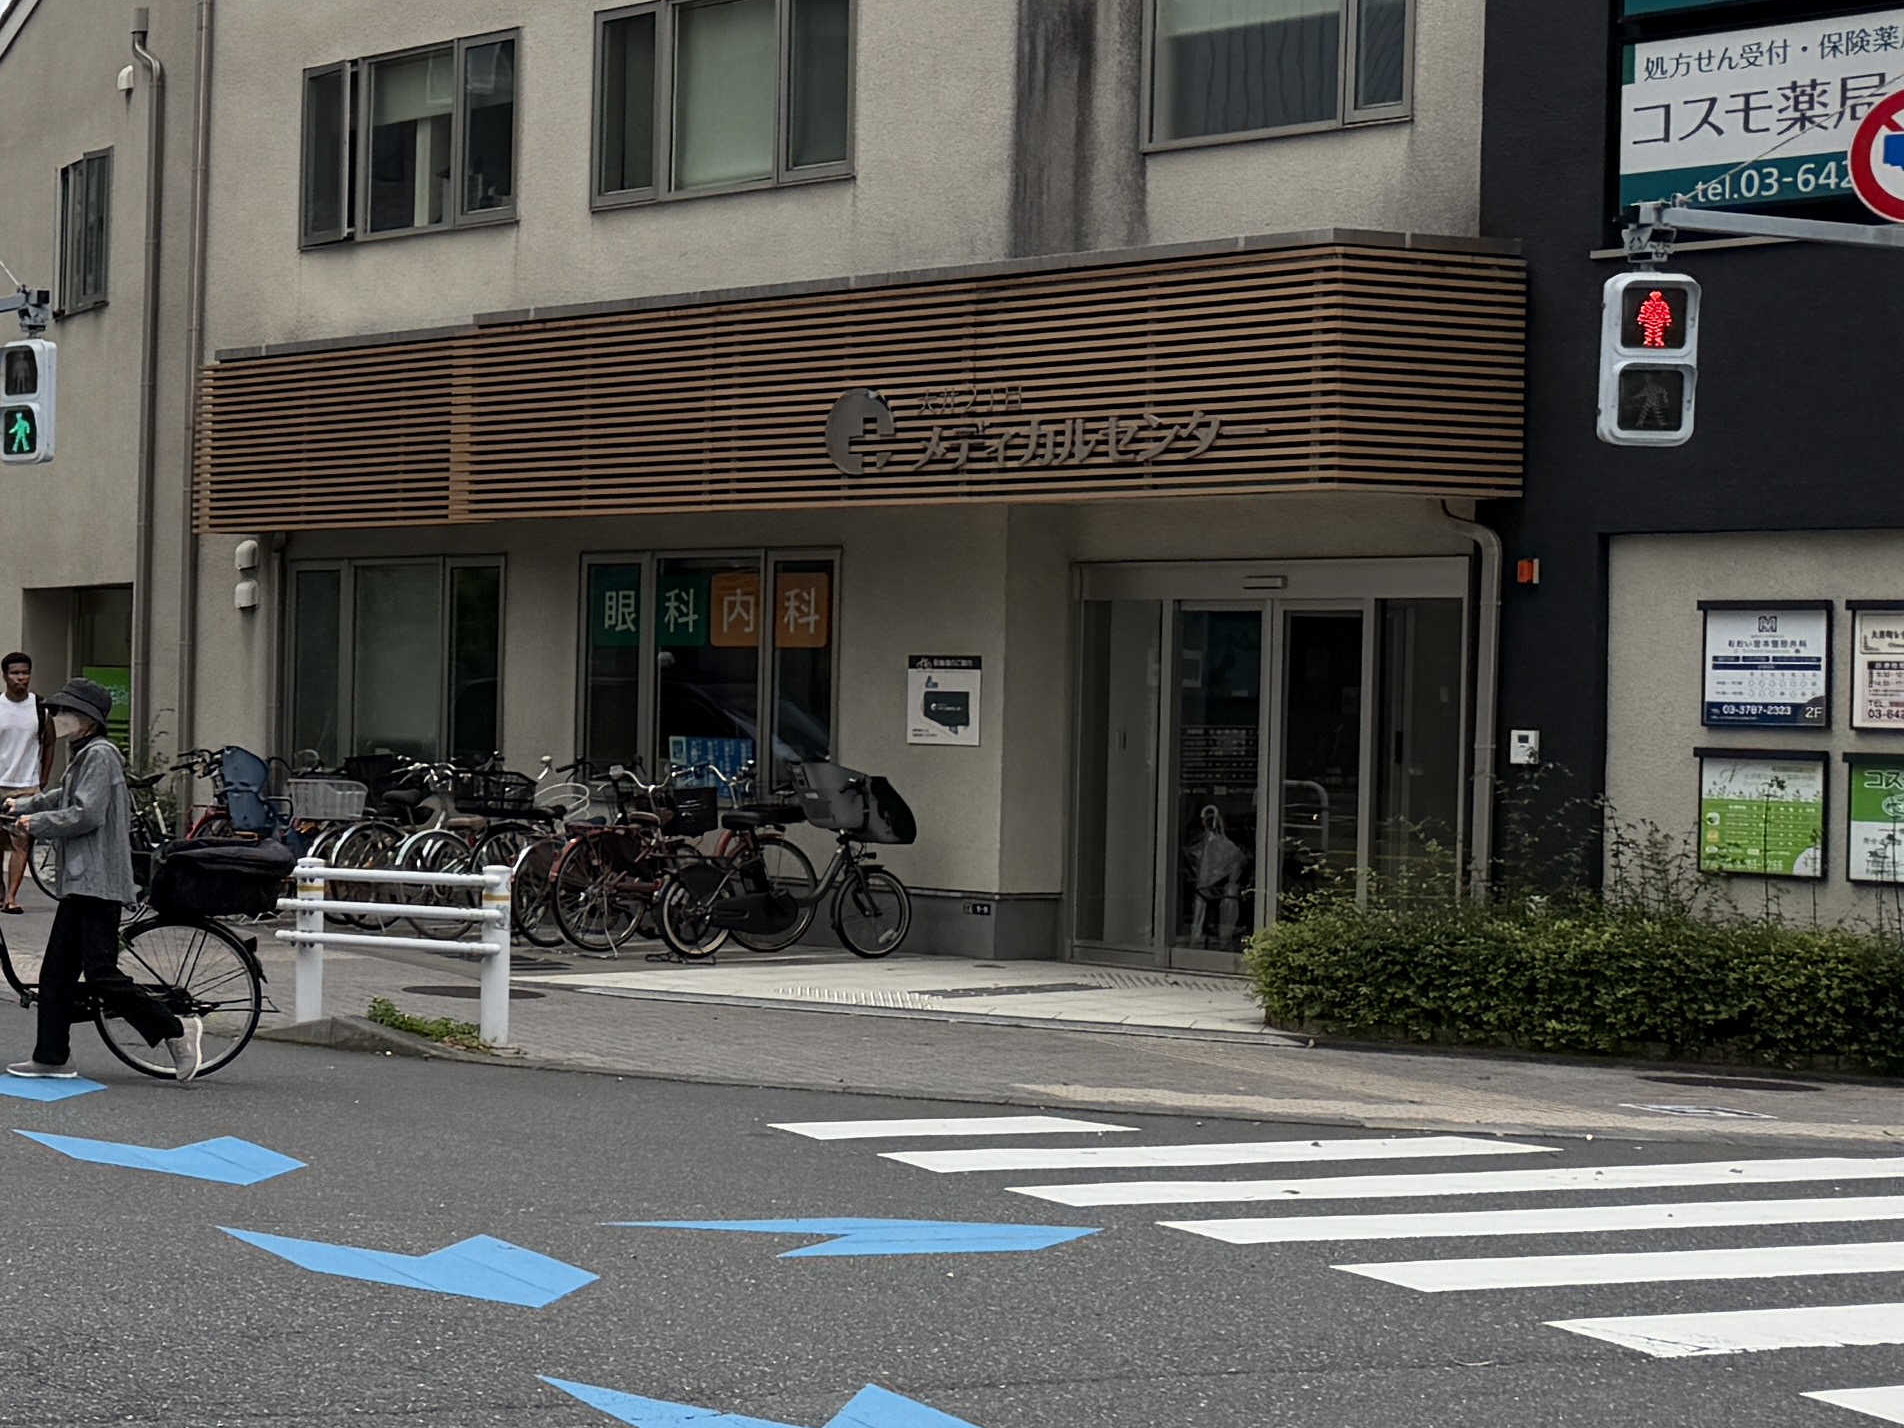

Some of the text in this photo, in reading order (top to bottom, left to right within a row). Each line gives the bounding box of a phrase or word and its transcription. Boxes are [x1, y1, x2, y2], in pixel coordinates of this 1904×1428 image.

[1643, 24, 1904, 82] 処方せん受付・保険薬
[1631, 71, 1889, 146] コスモ薬局
[913, 410, 1270, 472] メディカルセンター
[603, 587, 821, 635] 眼科 内科
[1804, 706, 1823, 719] 2F
